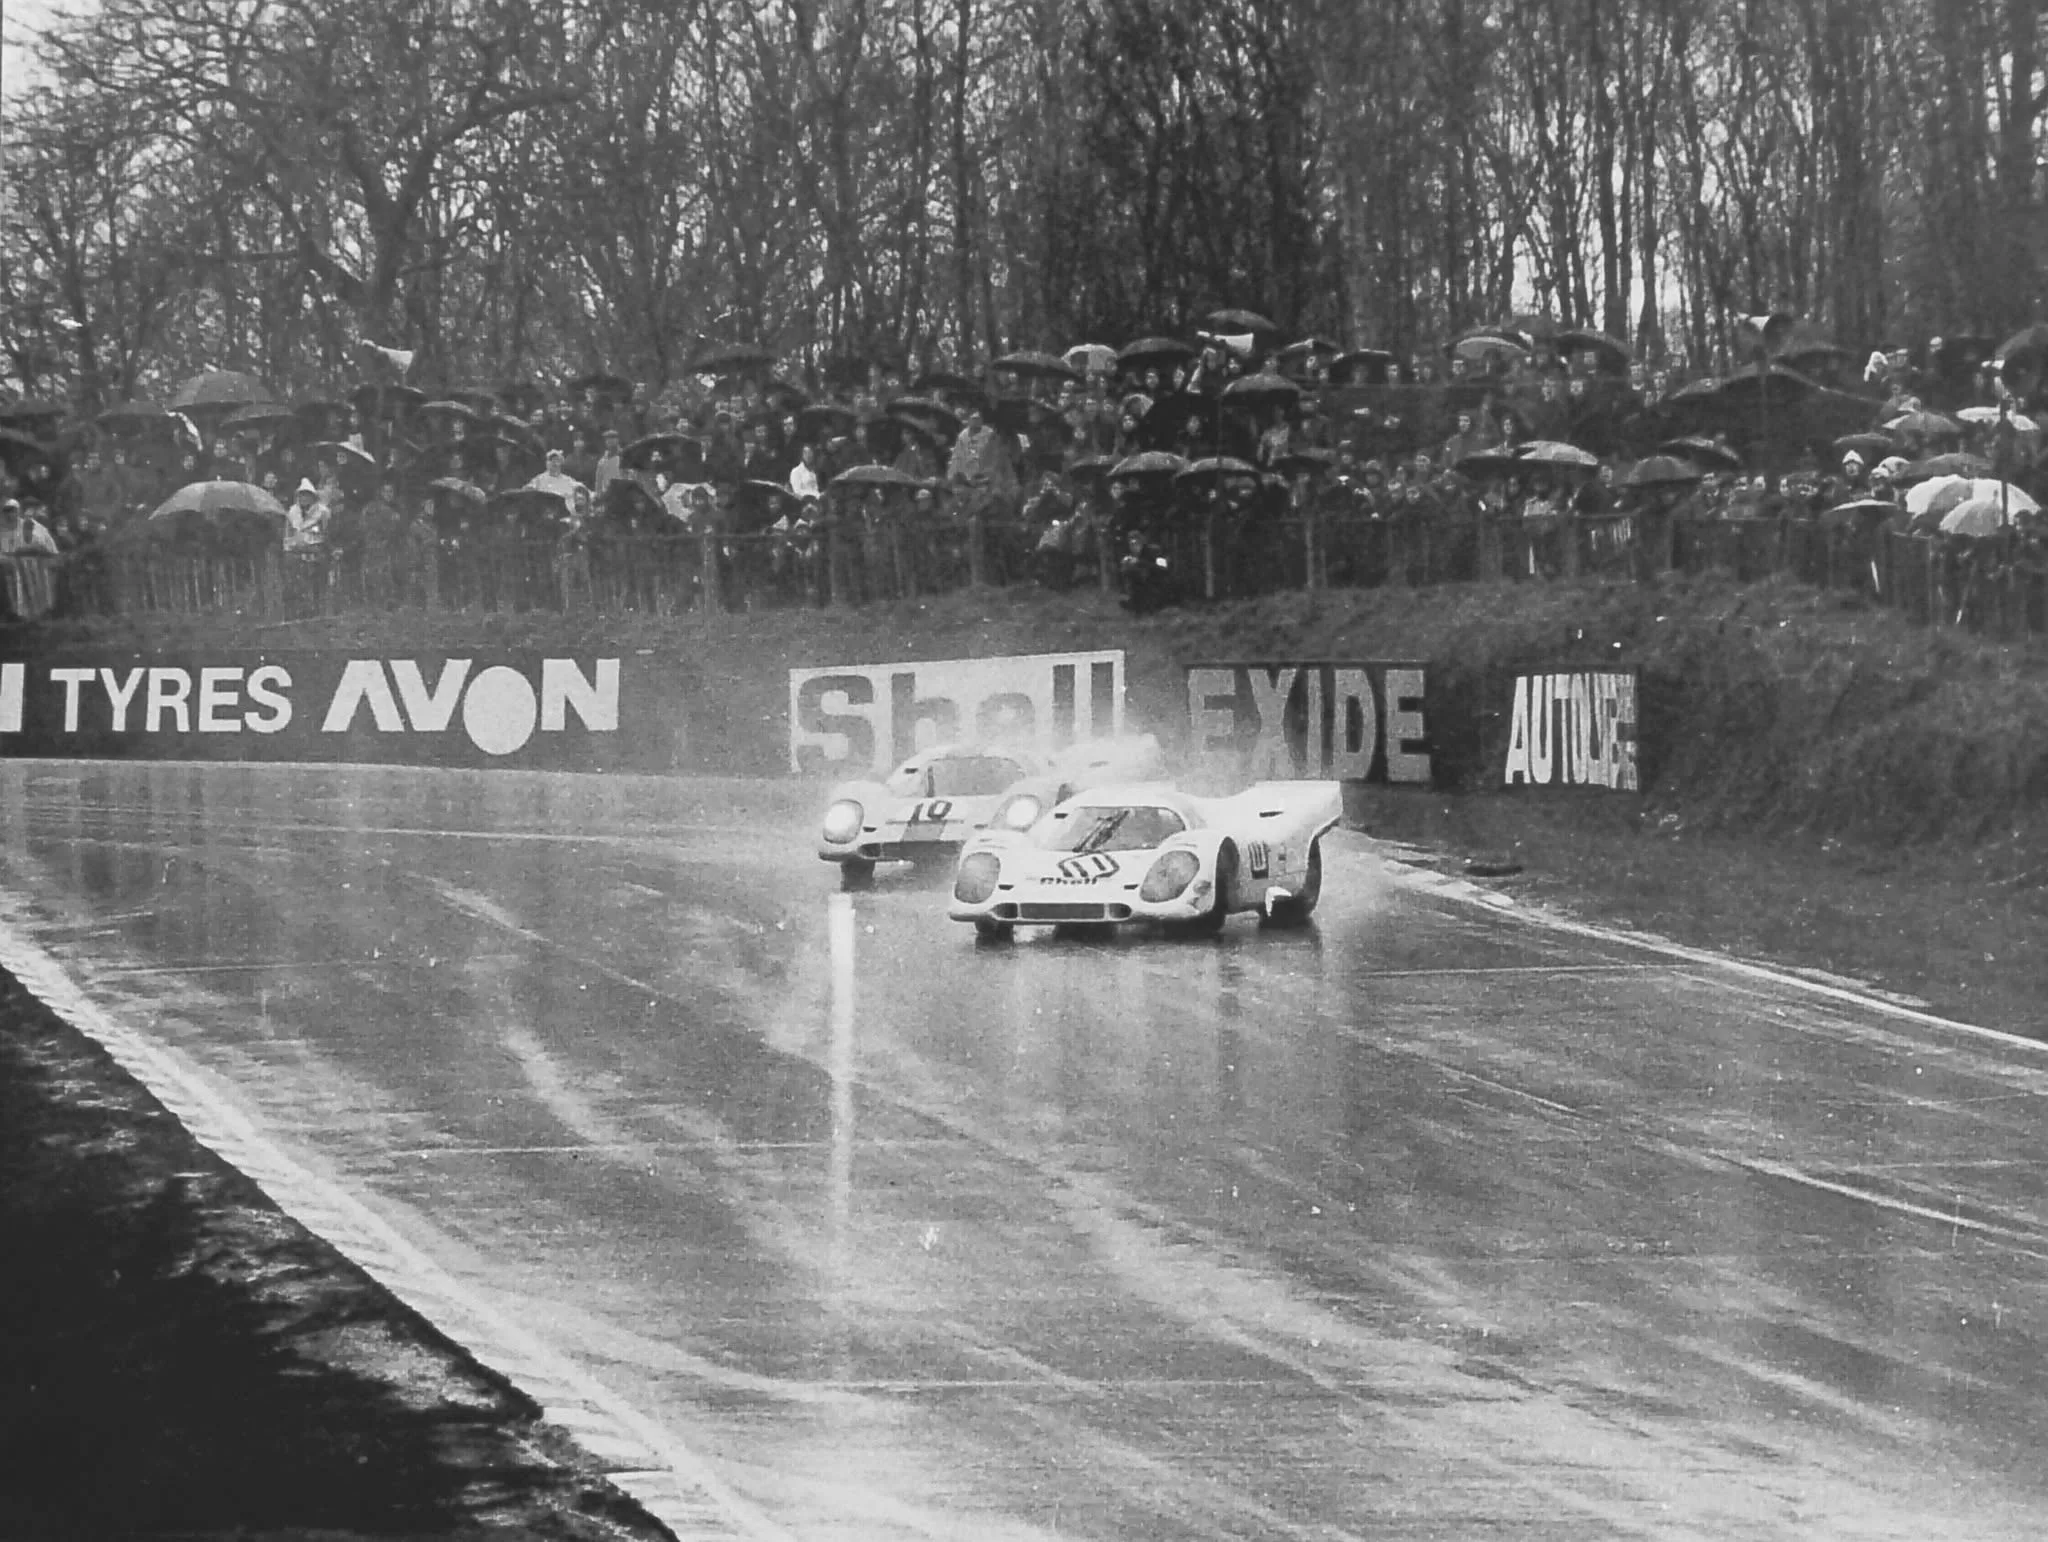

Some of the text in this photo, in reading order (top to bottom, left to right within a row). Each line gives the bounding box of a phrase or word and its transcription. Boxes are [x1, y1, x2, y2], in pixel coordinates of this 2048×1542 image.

[50, 666, 292, 733] TYRES
[321, 658, 620, 755] AVON
[1188, 669, 1431, 782] EXIDE
[907, 800, 953, 826] 10
